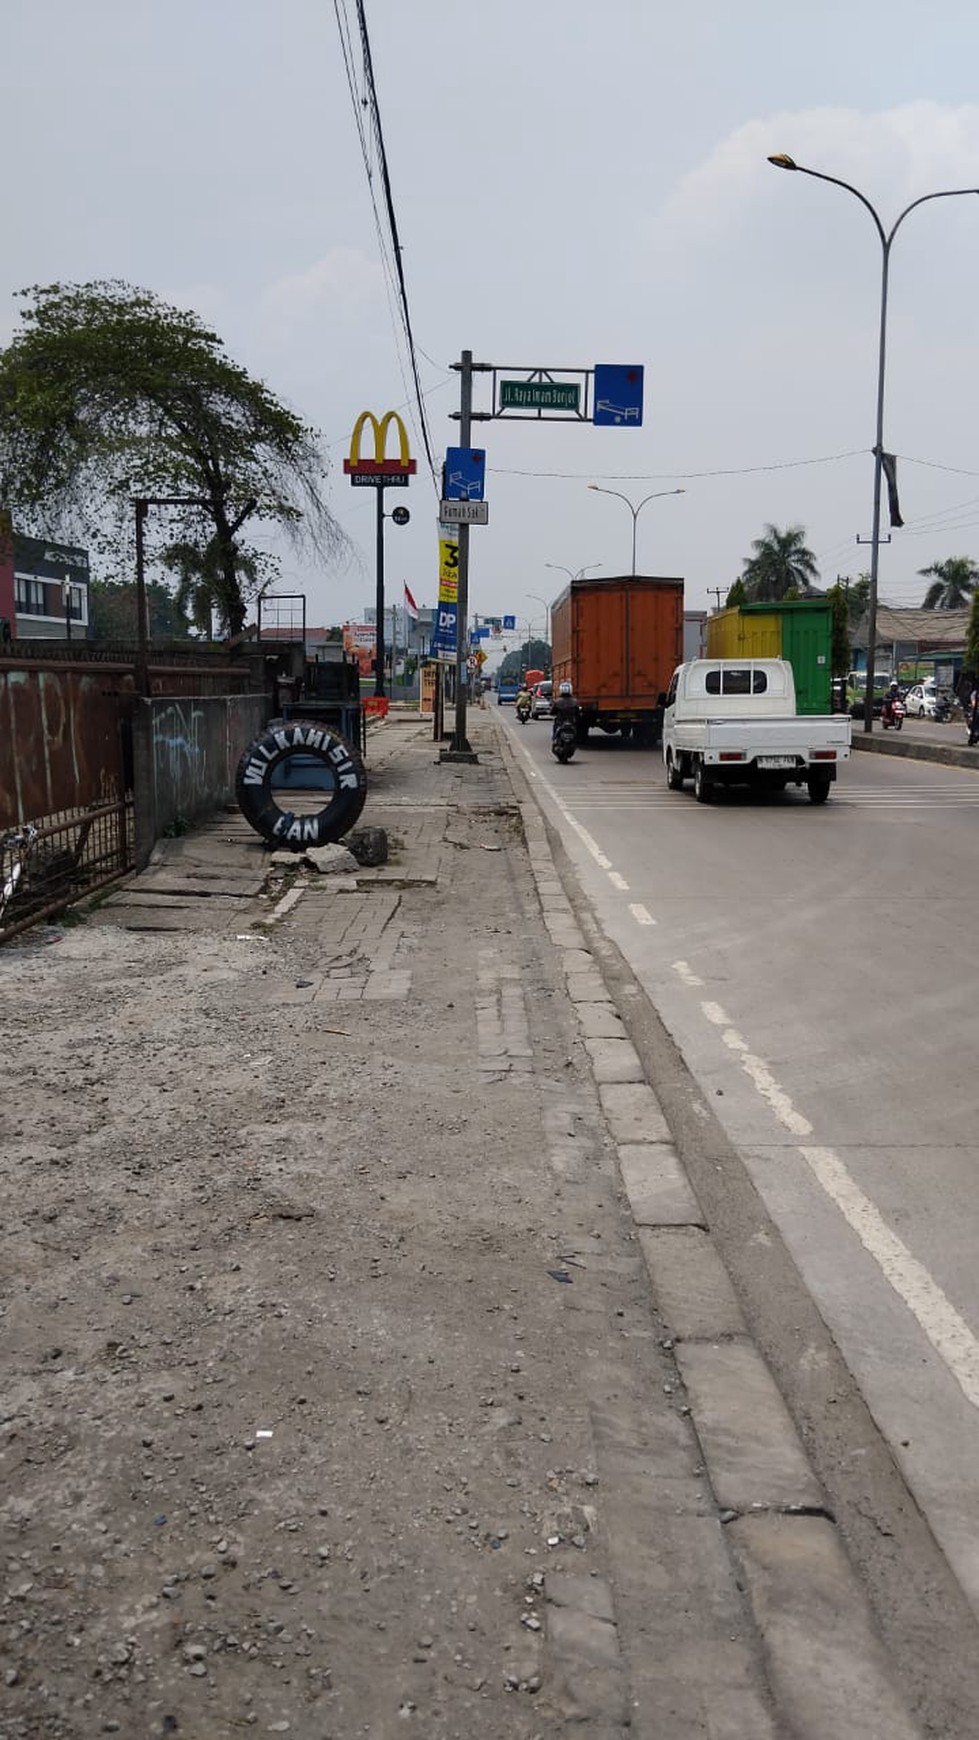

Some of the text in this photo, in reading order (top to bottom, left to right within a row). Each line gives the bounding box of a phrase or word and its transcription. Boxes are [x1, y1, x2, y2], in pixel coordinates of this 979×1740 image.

[514, 387, 531, 406] Raya
[532, 389, 551, 403] Imam
[355, 475, 405, 484] DRIVE THRU
[444, 543, 459, 568] 3
[439, 612, 456, 628] DP
